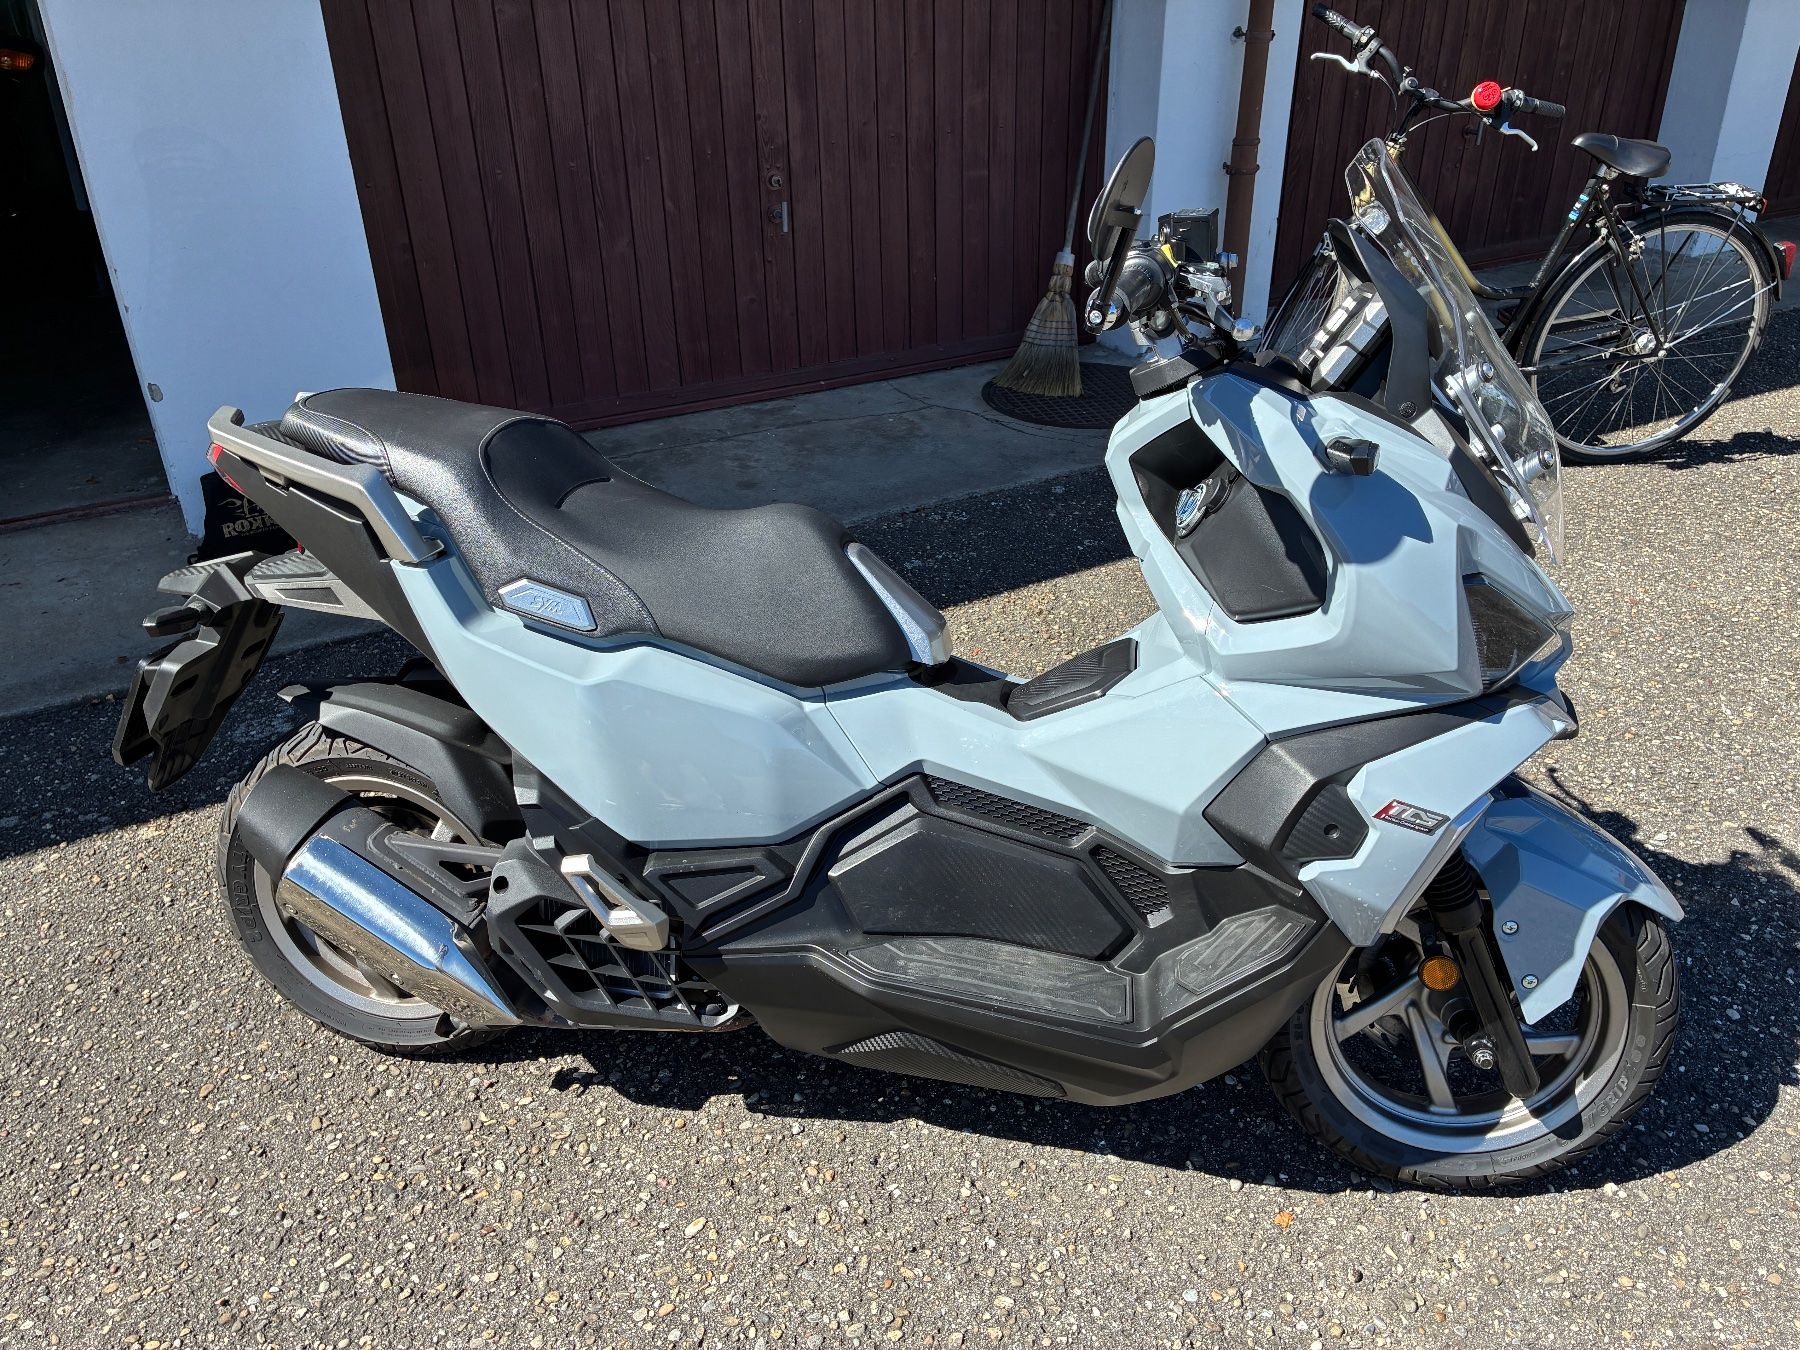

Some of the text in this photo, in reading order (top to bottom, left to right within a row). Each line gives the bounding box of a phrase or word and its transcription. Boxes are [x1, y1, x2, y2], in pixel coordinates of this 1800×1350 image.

[530, 595, 564, 614] SYM
[1388, 802, 1444, 827] TCS
[1596, 1075, 1629, 1117] GRIP
